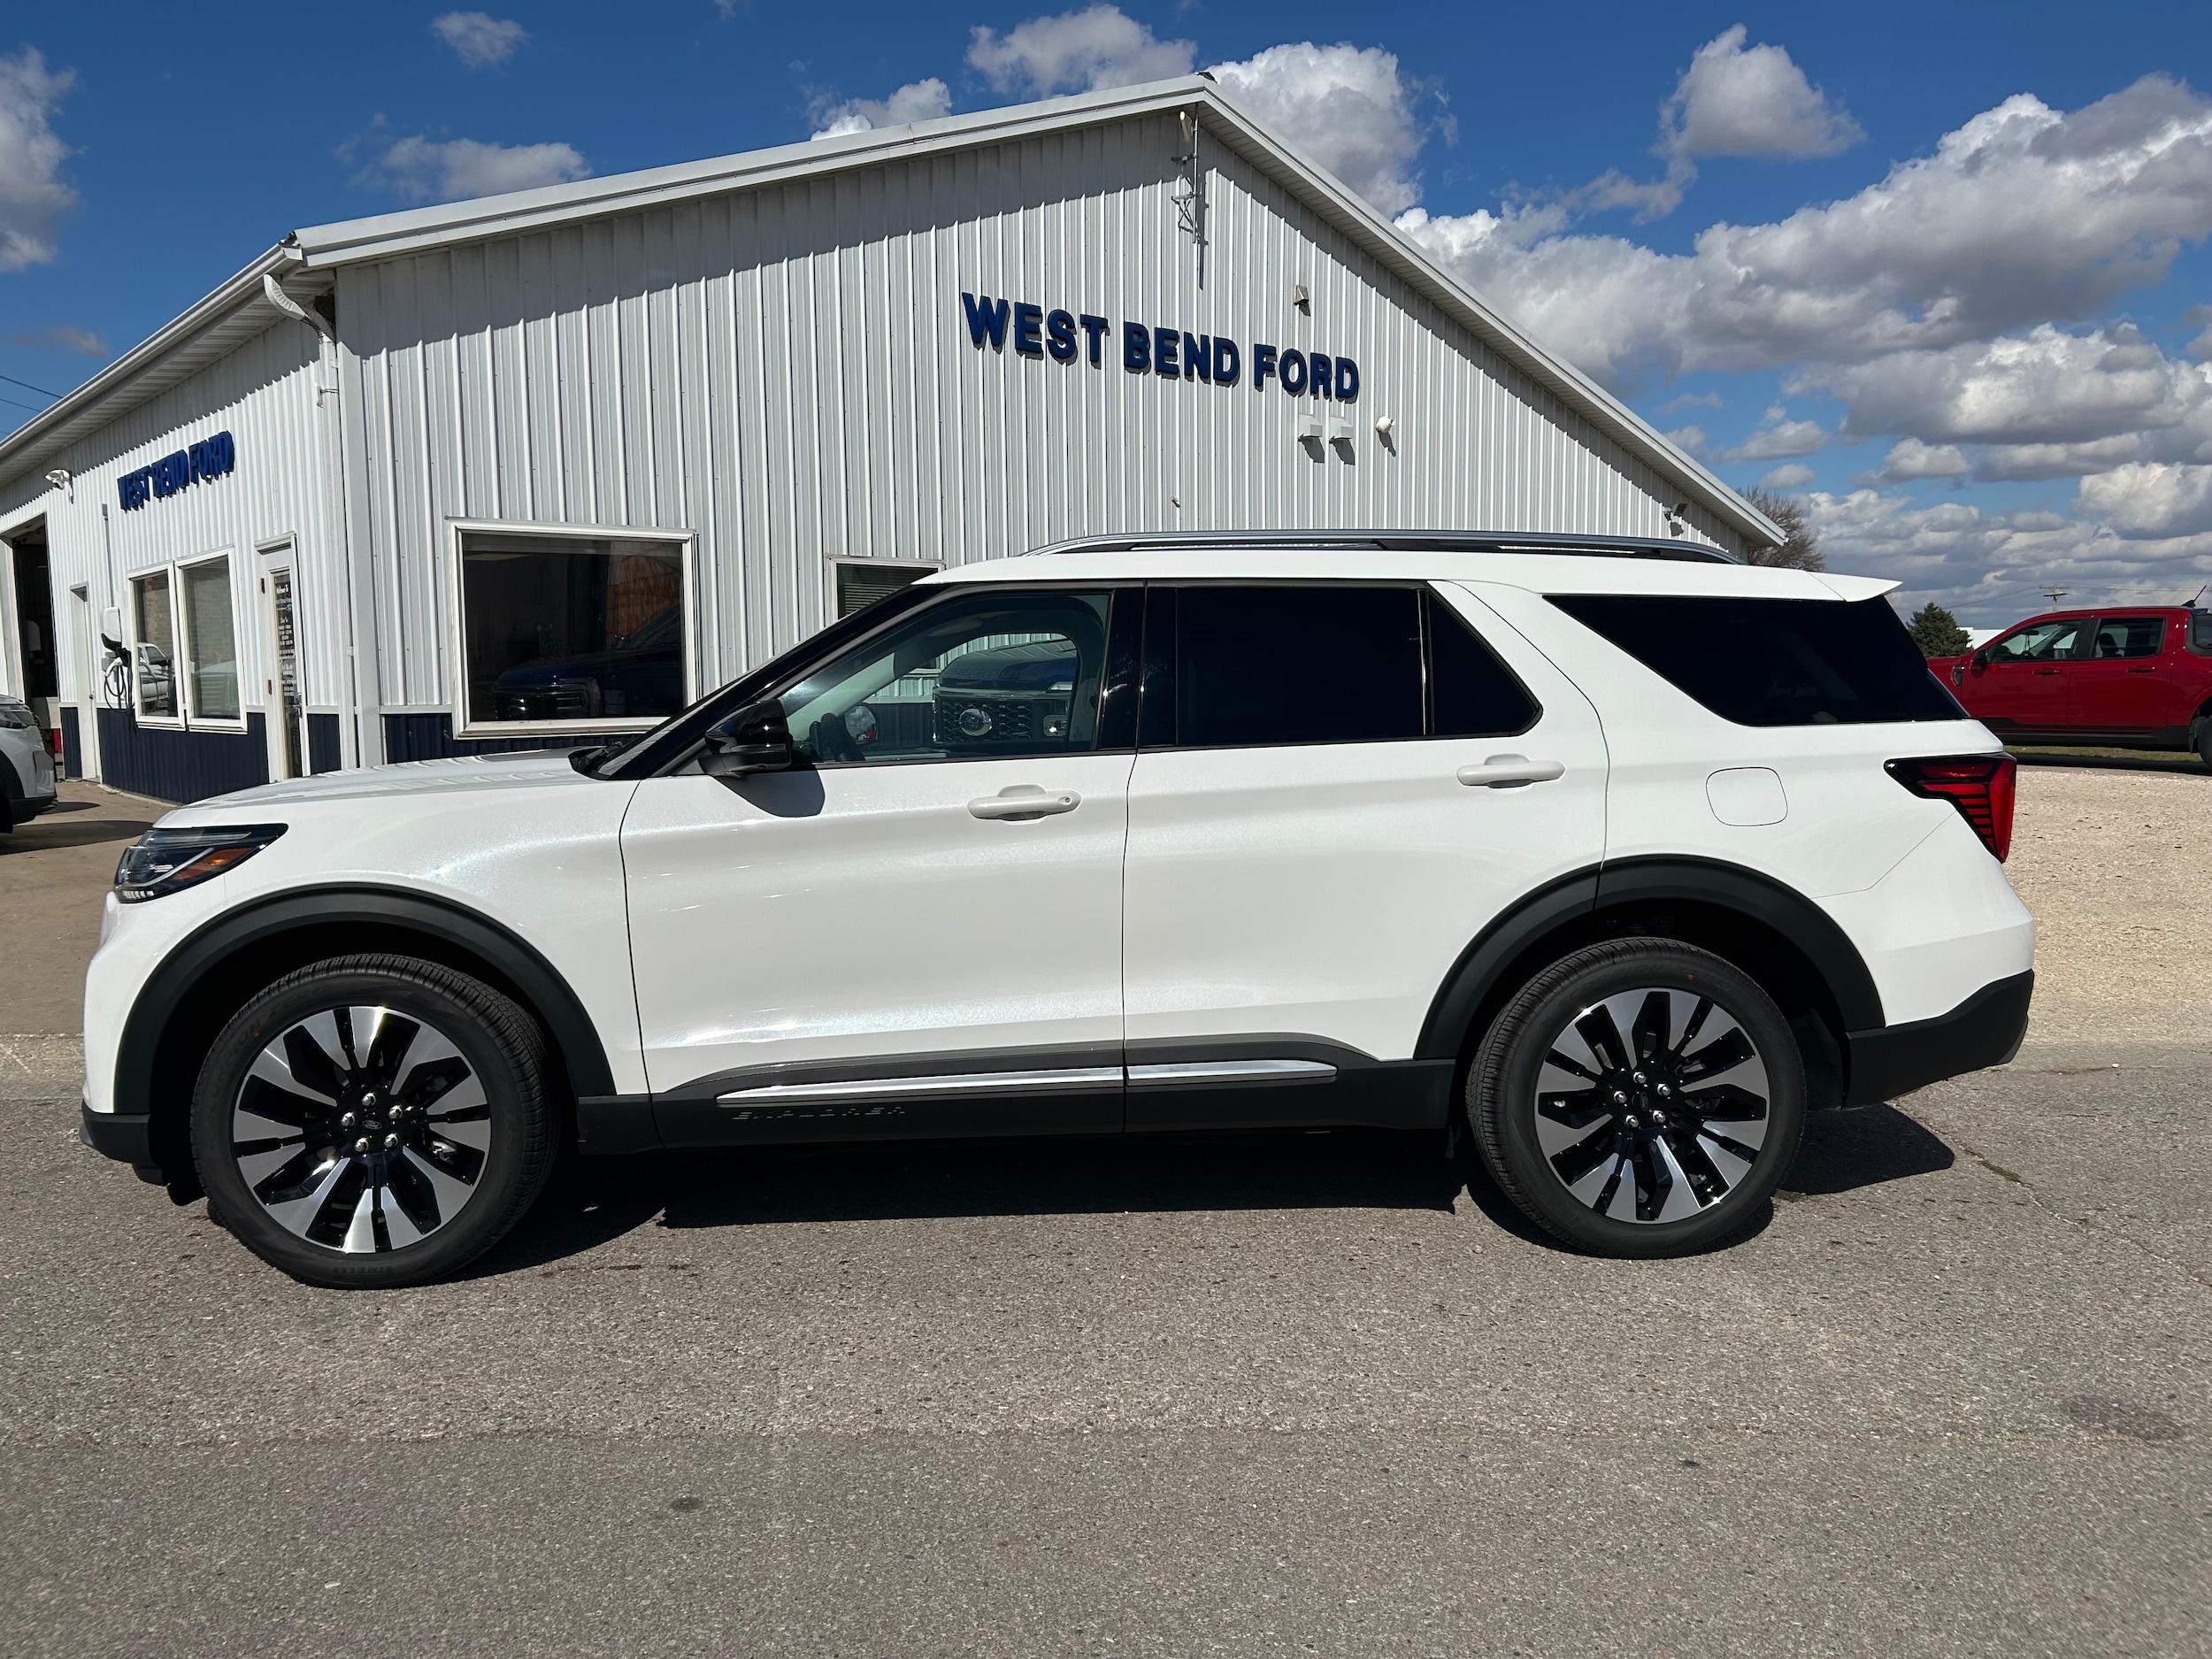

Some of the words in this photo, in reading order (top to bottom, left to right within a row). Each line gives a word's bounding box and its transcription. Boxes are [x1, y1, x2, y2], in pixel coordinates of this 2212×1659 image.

[962, 292, 1109, 364] WEST
[1123, 321, 1240, 382] BEND
[1254, 344, 1359, 399] FORD
[151, 449, 190, 497] BEND
[188, 430, 235, 485] FORD
